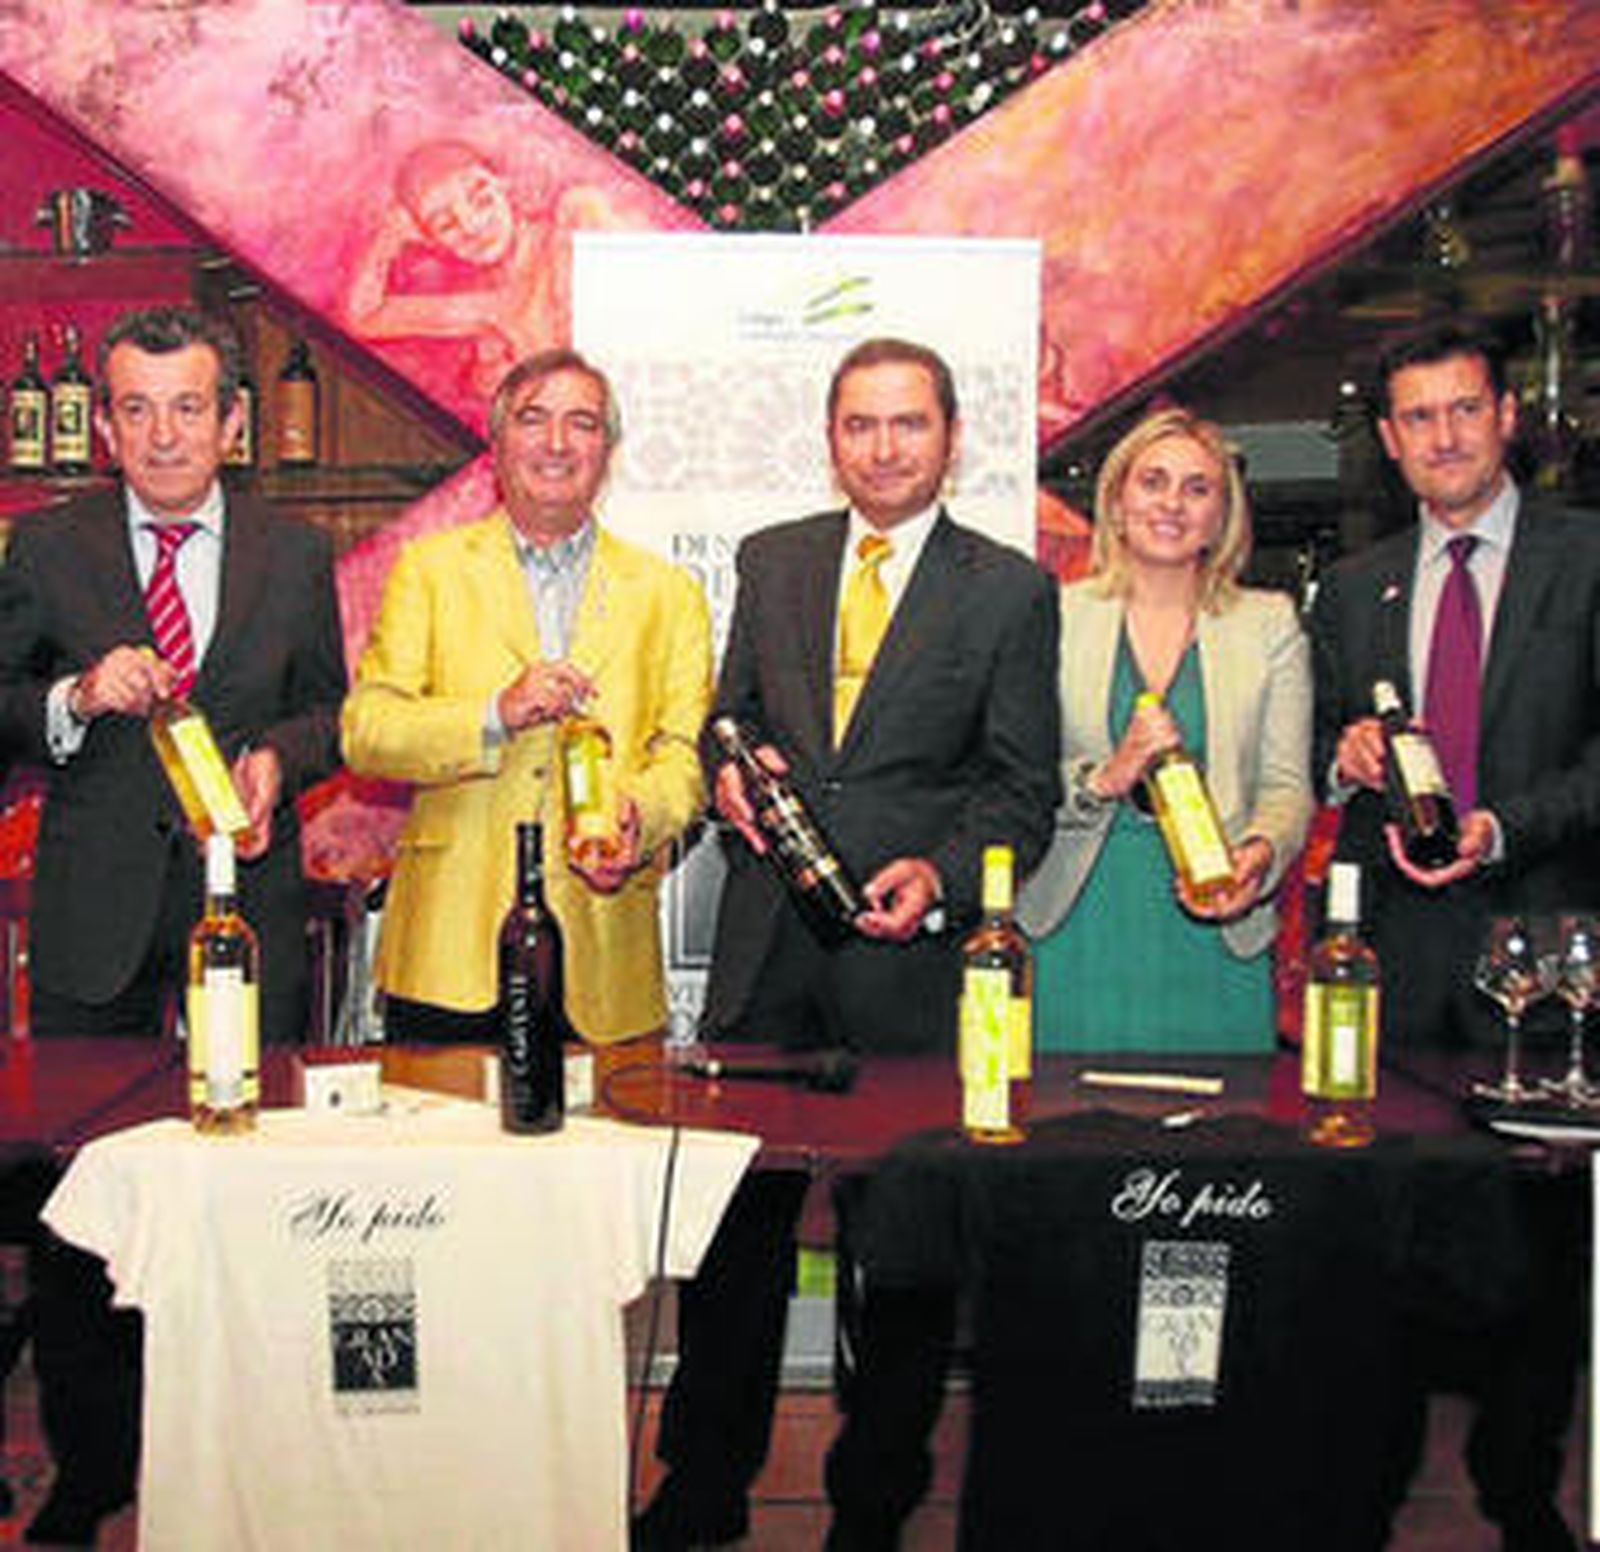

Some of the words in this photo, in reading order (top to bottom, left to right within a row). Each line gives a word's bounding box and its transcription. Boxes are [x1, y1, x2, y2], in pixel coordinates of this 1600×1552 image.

[287, 1192, 355, 1238] Yo
[361, 1193, 447, 1243] pido
[1110, 1167, 1183, 1223] Yo
[1179, 1180, 1276, 1228] pido
